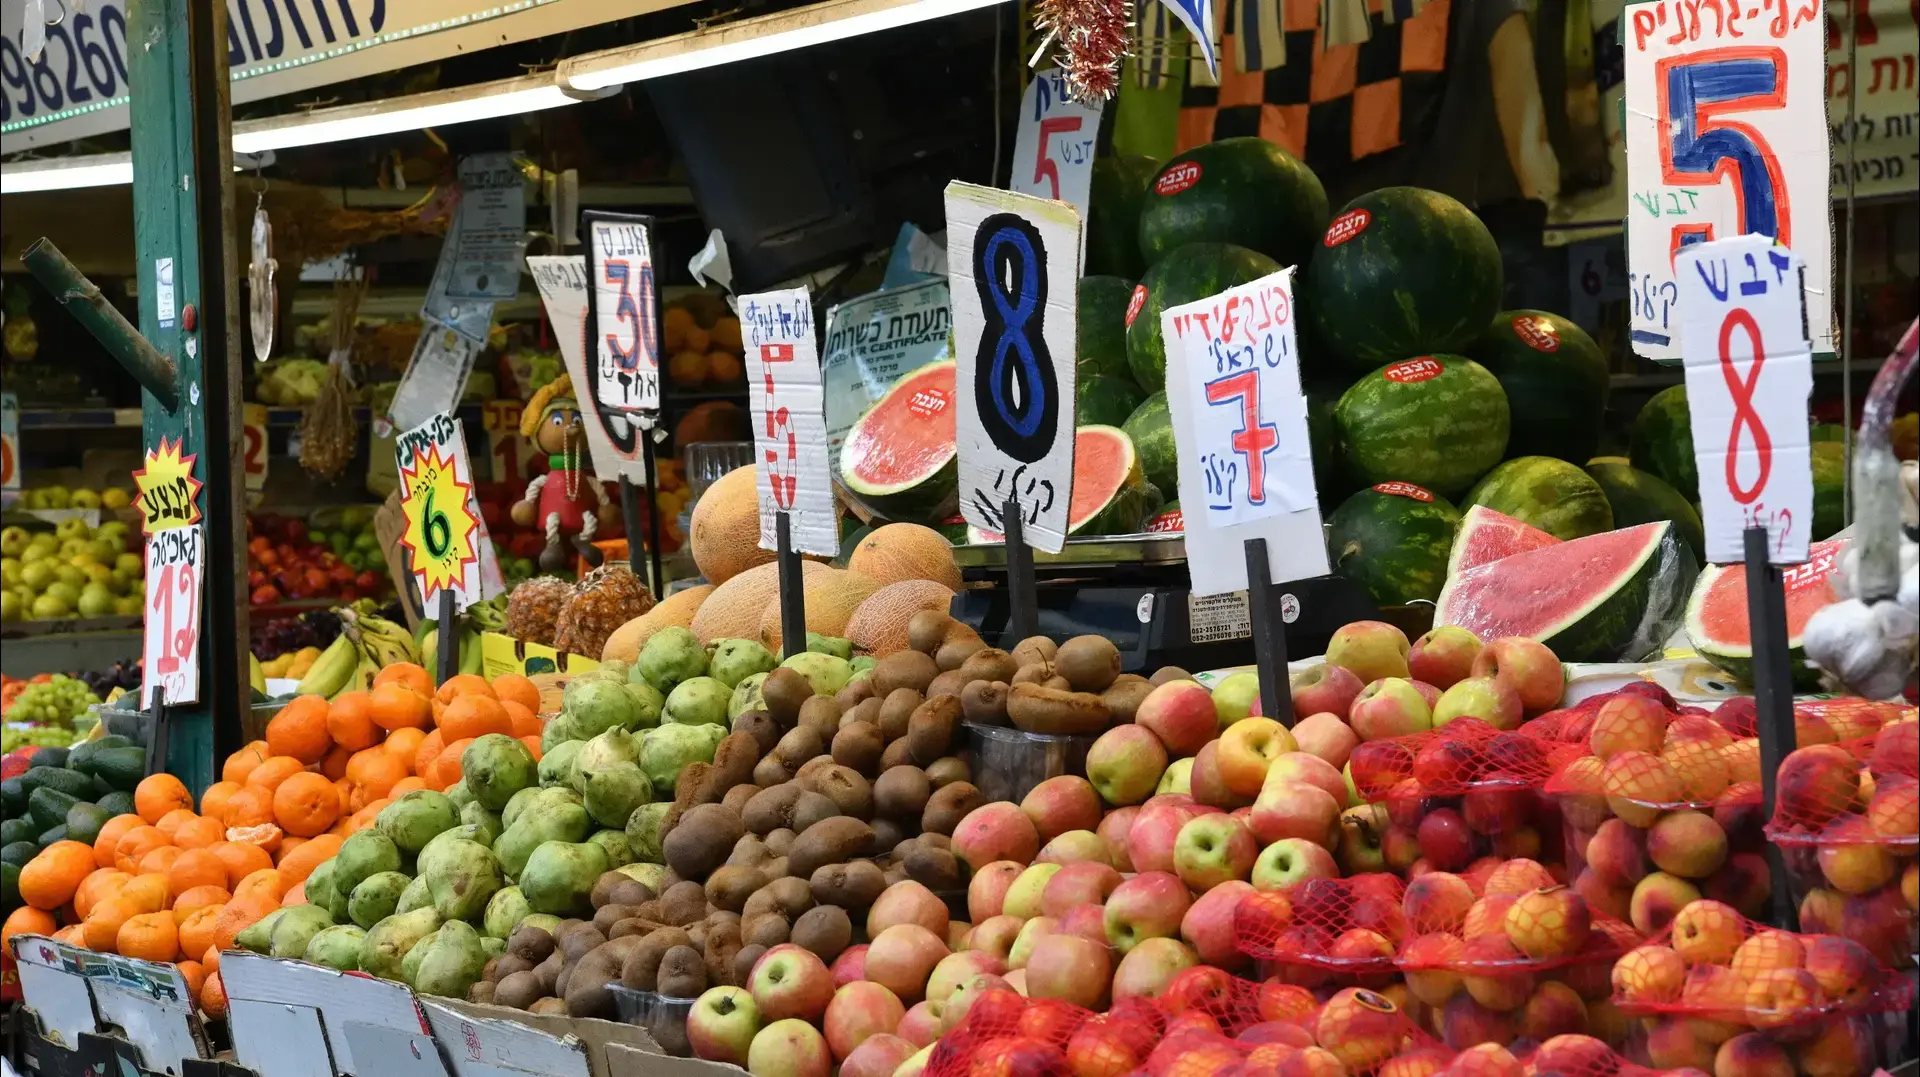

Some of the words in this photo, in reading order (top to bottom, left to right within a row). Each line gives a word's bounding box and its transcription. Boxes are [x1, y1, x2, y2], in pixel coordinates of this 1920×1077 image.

[1034, 116, 1082, 200] 5
[1060, 139, 1093, 165] דבש
[1655, 46, 1791, 276] 5
[1158, 166, 1197, 189] חצבה
[1633, 188, 1699, 218] דבש
[1326, 214, 1366, 241] חצבה
[1695, 250, 1790, 303] דבש
[603, 259, 658, 374] 30
[886, 305, 949, 340] תעודת
[1629, 273, 1677, 329] קילו
[829, 320, 882, 357] כשרות
[869, 330, 947, 354] CERTIFICATE
[973, 213, 1061, 464] 8
[1387, 360, 1439, 378] חצבה
[911, 392, 946, 412] חצבה
[1718, 307, 1773, 505] 8
[760, 343, 797, 510] 5
[1205, 366, 1280, 507] 7
[143, 475, 191, 524] מבצע
[1201, 453, 1237, 503] קילו
[1377, 483, 1429, 499] חצבה
[421, 486, 452, 561] 6
[152, 527, 199, 569] לאכילה
[1782, 554, 1833, 584] צבה
